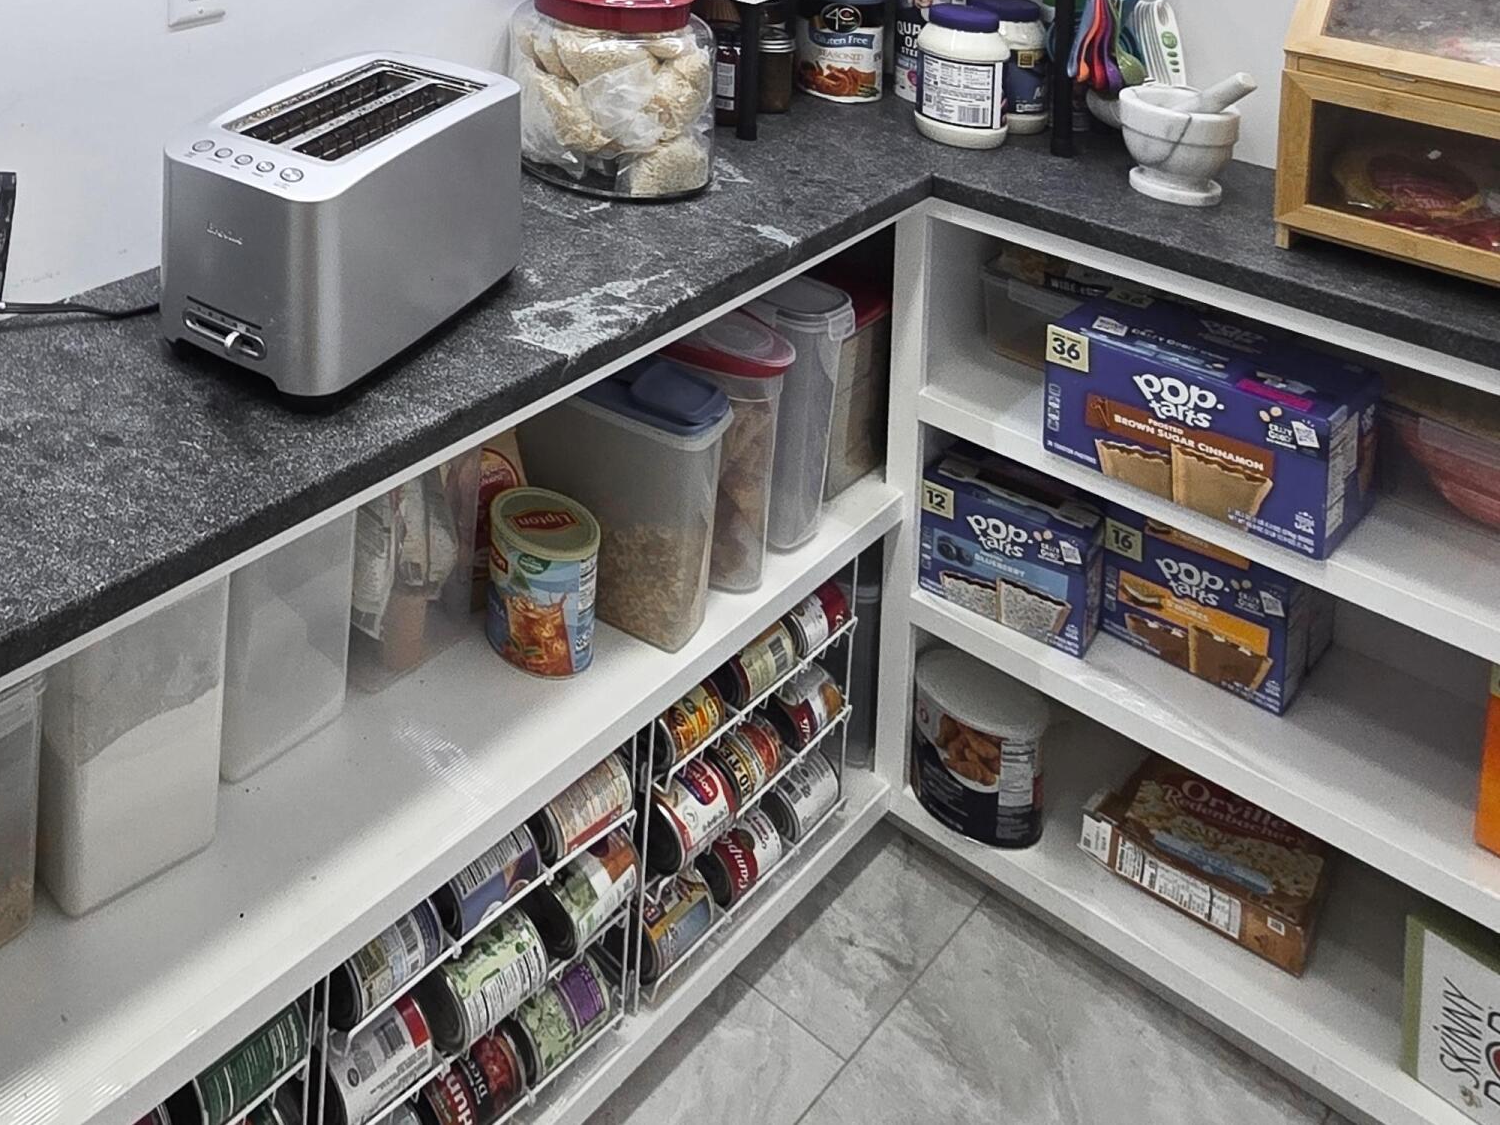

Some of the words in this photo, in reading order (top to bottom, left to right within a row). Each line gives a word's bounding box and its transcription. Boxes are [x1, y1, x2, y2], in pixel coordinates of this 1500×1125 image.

[814, 33, 844, 46] Gluten
[849, 35, 868, 45] Free
[1052, 336, 1081, 361] 36
[1148, 418, 1184, 434] FROSTED
[1150, 401, 1212, 428] tarts
[1114, 414, 1155, 436] BROWN
[1157, 429, 1195, 448] SUGAR
[1197, 442, 1264, 471] CINNAMON
[926, 491, 945, 507] 12
[979, 535, 1023, 558] tarts
[1113, 531, 1132, 550] 16
[974, 552, 1025, 577] BLUEBERRY
[1168, 584, 1220, 606] tarts
[1162, 784, 1296, 844] Redenbacher
[1182, 780, 1288, 830] Orville
[1433, 977, 1484, 1089] SKINNY
